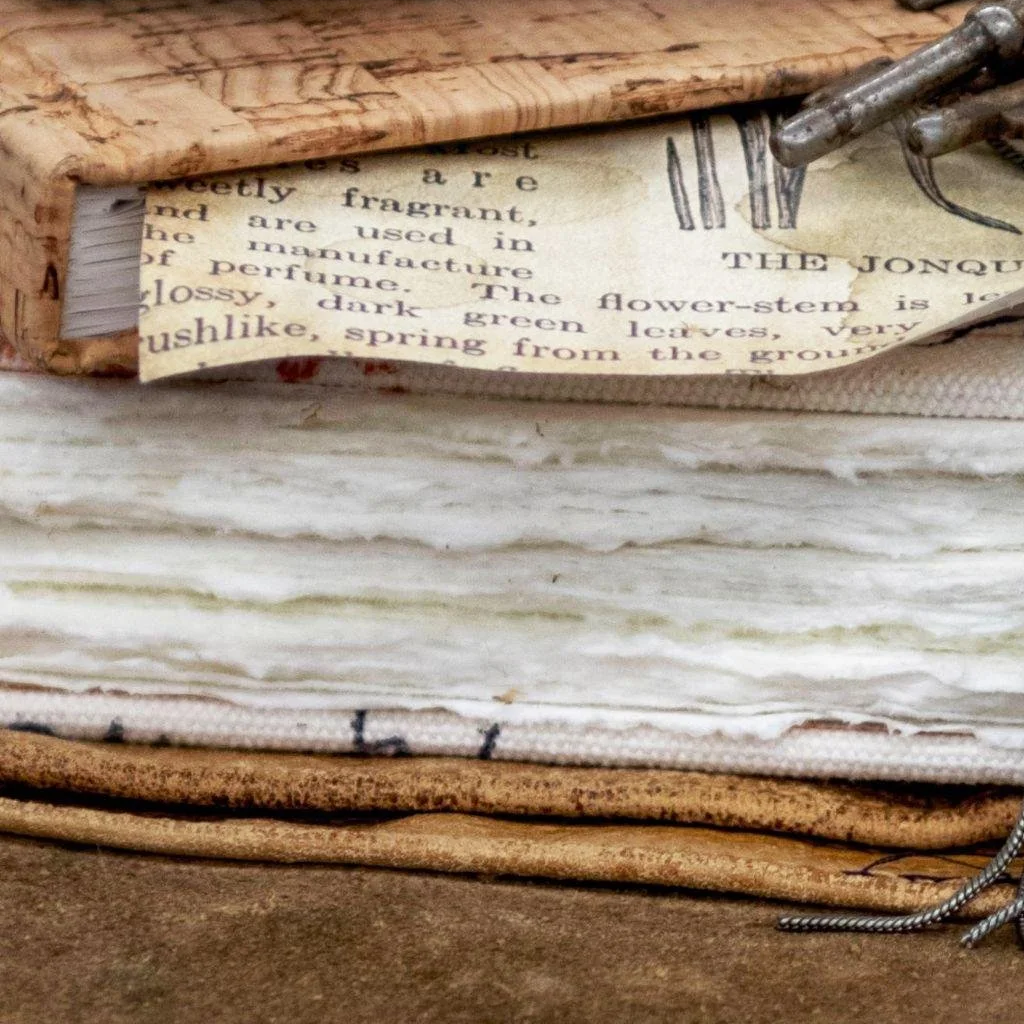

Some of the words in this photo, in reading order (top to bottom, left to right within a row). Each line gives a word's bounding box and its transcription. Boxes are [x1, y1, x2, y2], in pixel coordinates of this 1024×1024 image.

[342, 187, 538, 227] fragrant,
[247, 214, 318, 233] are
[354, 225, 456, 246] used
[493, 231, 535, 252] in
[209, 259, 412, 293] perfume.
[249, 239, 534, 280] manufacture
[721, 252, 829, 272] THE
[471, 282, 562, 306] The
[597, 292, 860, 313] flower-stem
[895, 295, 930, 311] is
[317, 295, 421, 318] dark
[463, 311, 587, 334] green
[626, 320, 781, 340] leaves,
[822, 321, 922, 336] very
[140, 314, 320, 354] ushlike,
[344, 327, 486, 356] spring
[512, 337, 621, 361] from
[649, 346, 722, 361] the
[749, 336, 907, 364] groun
